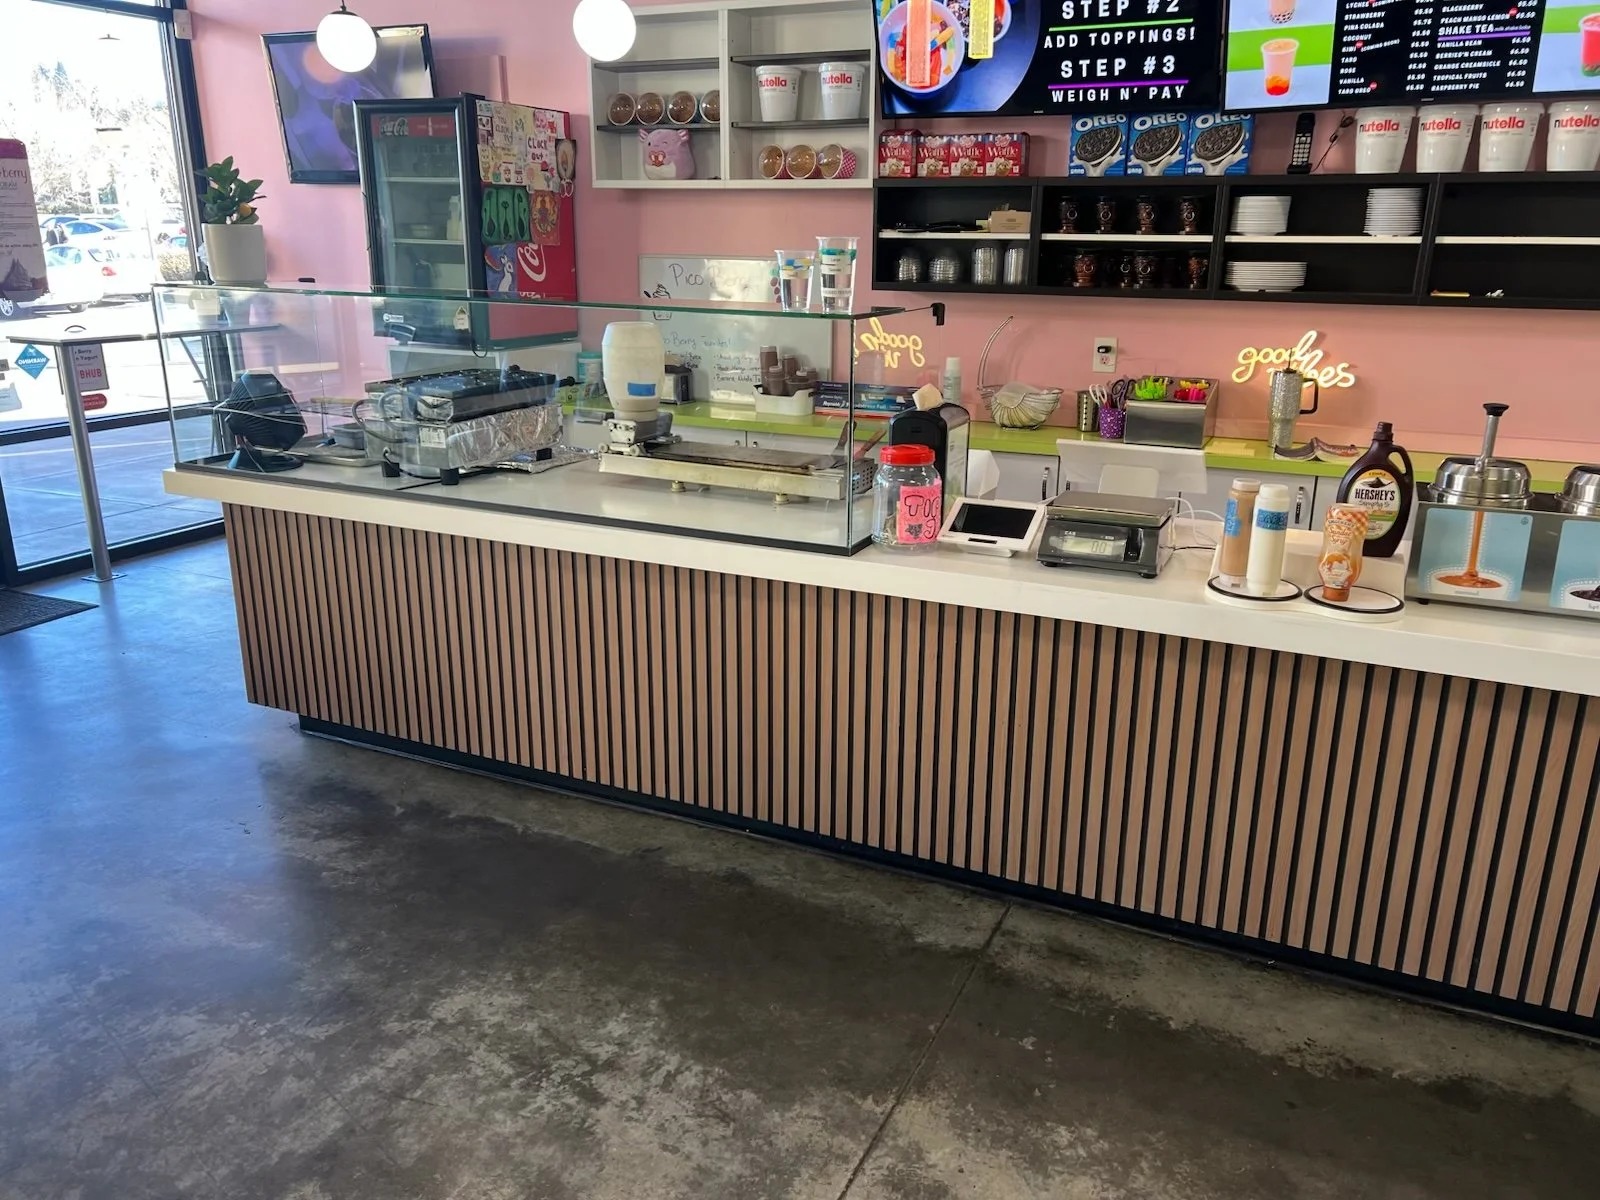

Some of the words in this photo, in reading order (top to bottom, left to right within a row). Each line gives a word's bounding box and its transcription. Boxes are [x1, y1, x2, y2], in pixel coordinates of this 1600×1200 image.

[1062, 0, 1129, 19] STEP
[1442, 4, 1484, 12] BLACKBERRY
[1344, 11, 1386, 20] STRAWBERRY
[1360, 22, 1385, 30] COLADA
[1438, 25, 1472, 35] SHAKE
[1475, 23, 1494, 33] TEA
[1044, 34, 1078, 48] ADD
[1089, 27, 1195, 46] TOPPINGS!
[1343, 34, 1372, 42] COCONUT
[1061, 58, 1127, 78] STEP
[1143, 55, 1175, 75] #3
[1460, 60, 1501, 68] CREAMSICLE
[822, 73, 853, 84] nutella
[1052, 88, 1109, 103] WEIGH
[1120, 87, 1138, 101] N'
[1149, 85, 1185, 99] PAY
[1075, 114, 1127, 132] OREO
[1133, 113, 1187, 131] OREO
[1360, 120, 1400, 133] nutella
[1420, 117, 1461, 131] nutella
[1482, 116, 1525, 130] nutella
[1554, 115, 1600, 128] nutella
[668, 263, 704, 287] Pico
[1232, 330, 1317, 383] good
[1355, 488, 1396, 501] HERSHEY'S
